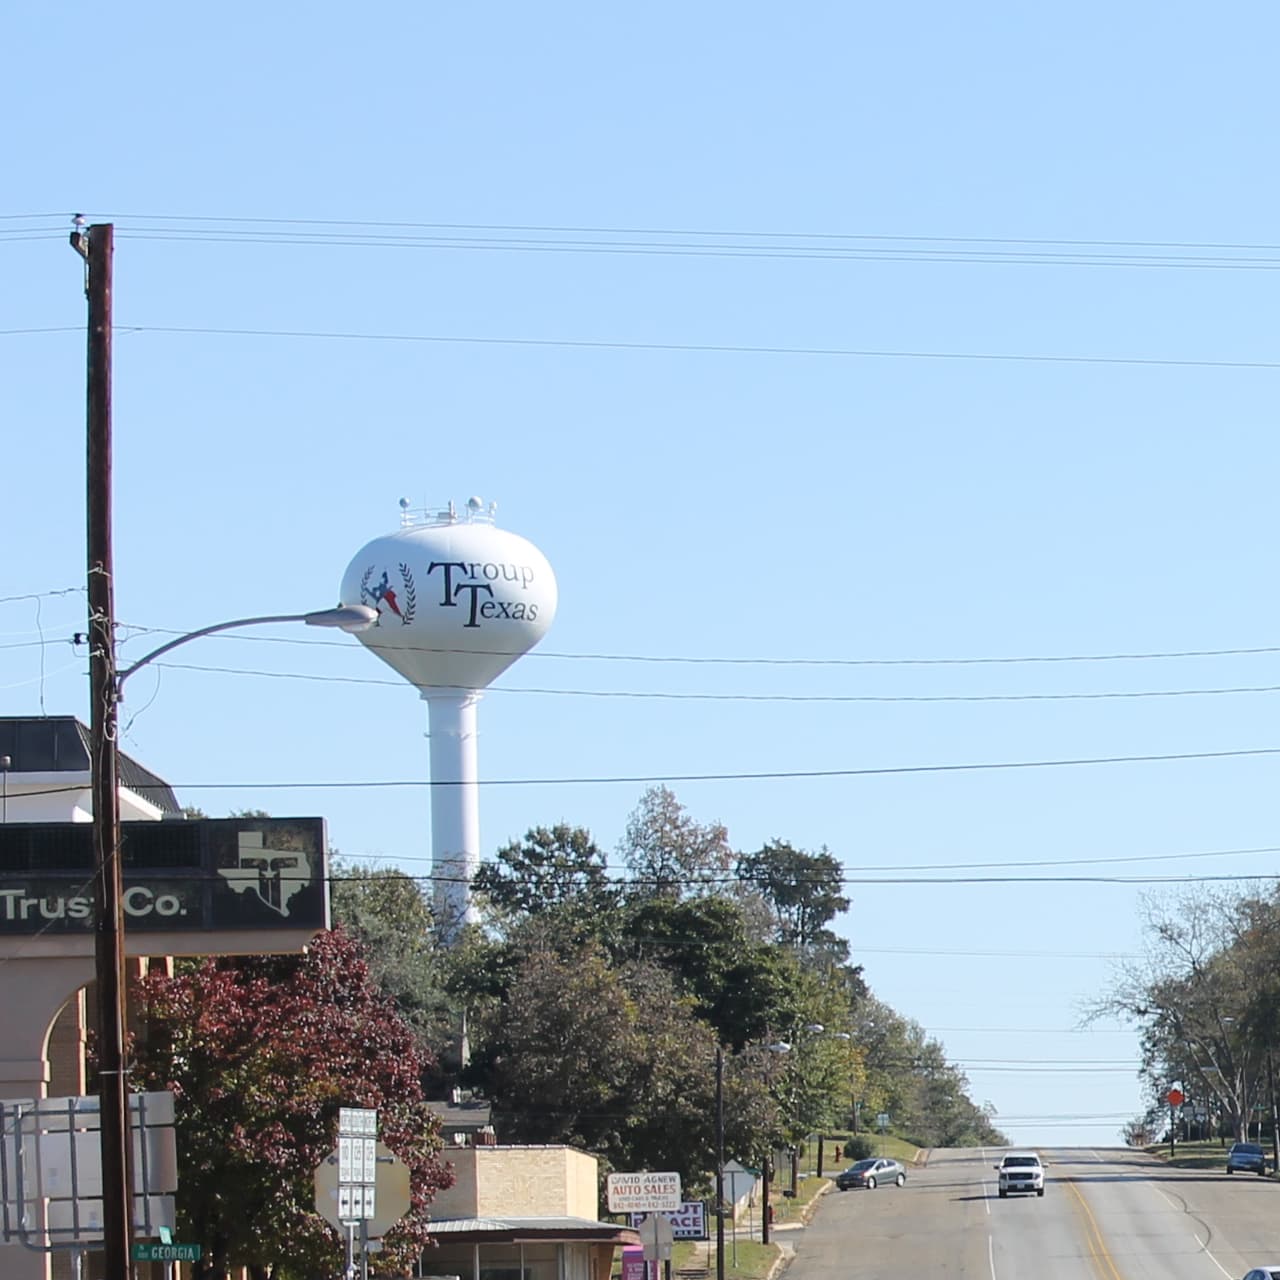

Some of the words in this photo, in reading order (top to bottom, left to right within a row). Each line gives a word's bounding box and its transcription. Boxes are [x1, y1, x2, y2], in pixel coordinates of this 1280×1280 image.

[427, 562, 534, 607] Troup
[454, 584, 538, 627] Texas
[0, 889, 94, 920] Trus
[124, 886, 187, 916] Co.
[613, 1186, 641, 1195] AUTO
[644, 1185, 676, 1194] SALES
[151, 1247, 194, 1259] GEORGIA
